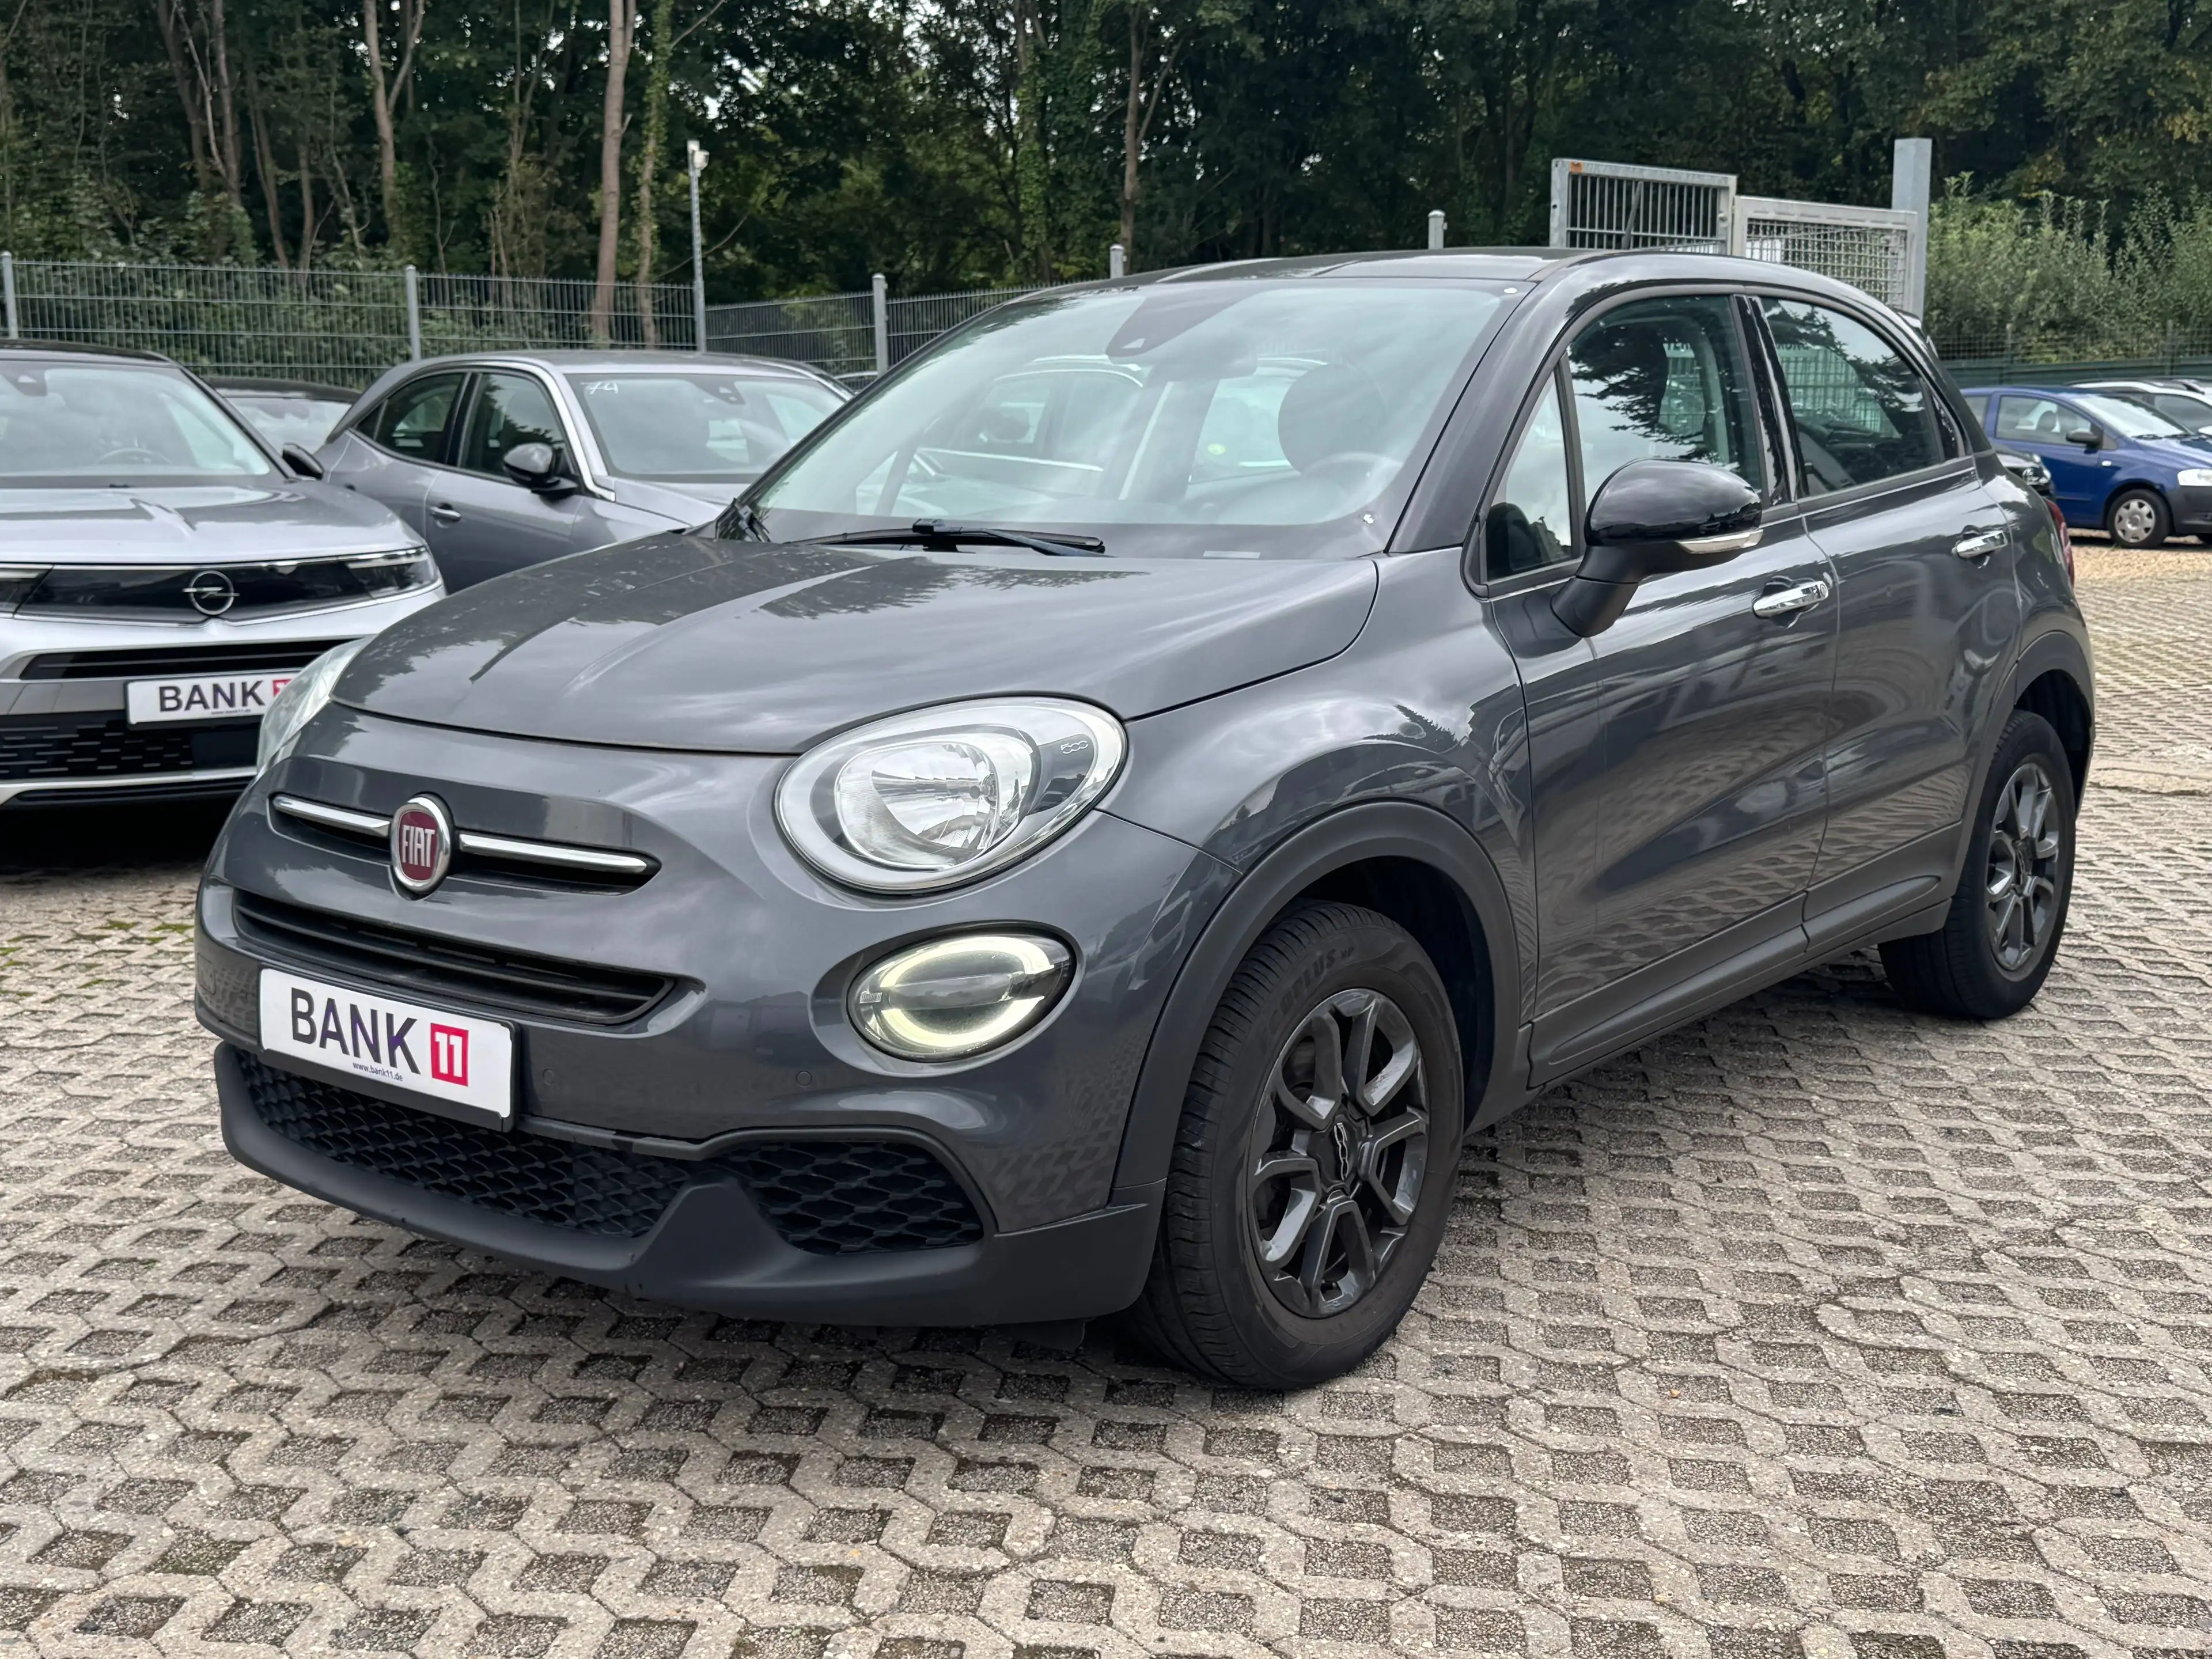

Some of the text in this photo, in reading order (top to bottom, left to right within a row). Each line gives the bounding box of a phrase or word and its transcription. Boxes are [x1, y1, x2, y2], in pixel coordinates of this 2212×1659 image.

[159, 680, 266, 712] BANK
[1060, 740, 1089, 754] 500
[403, 824, 435, 868] FIAT
[291, 987, 464, 1078] BANK 11
[353, 1062, 403, 1082] www.bank11.de
